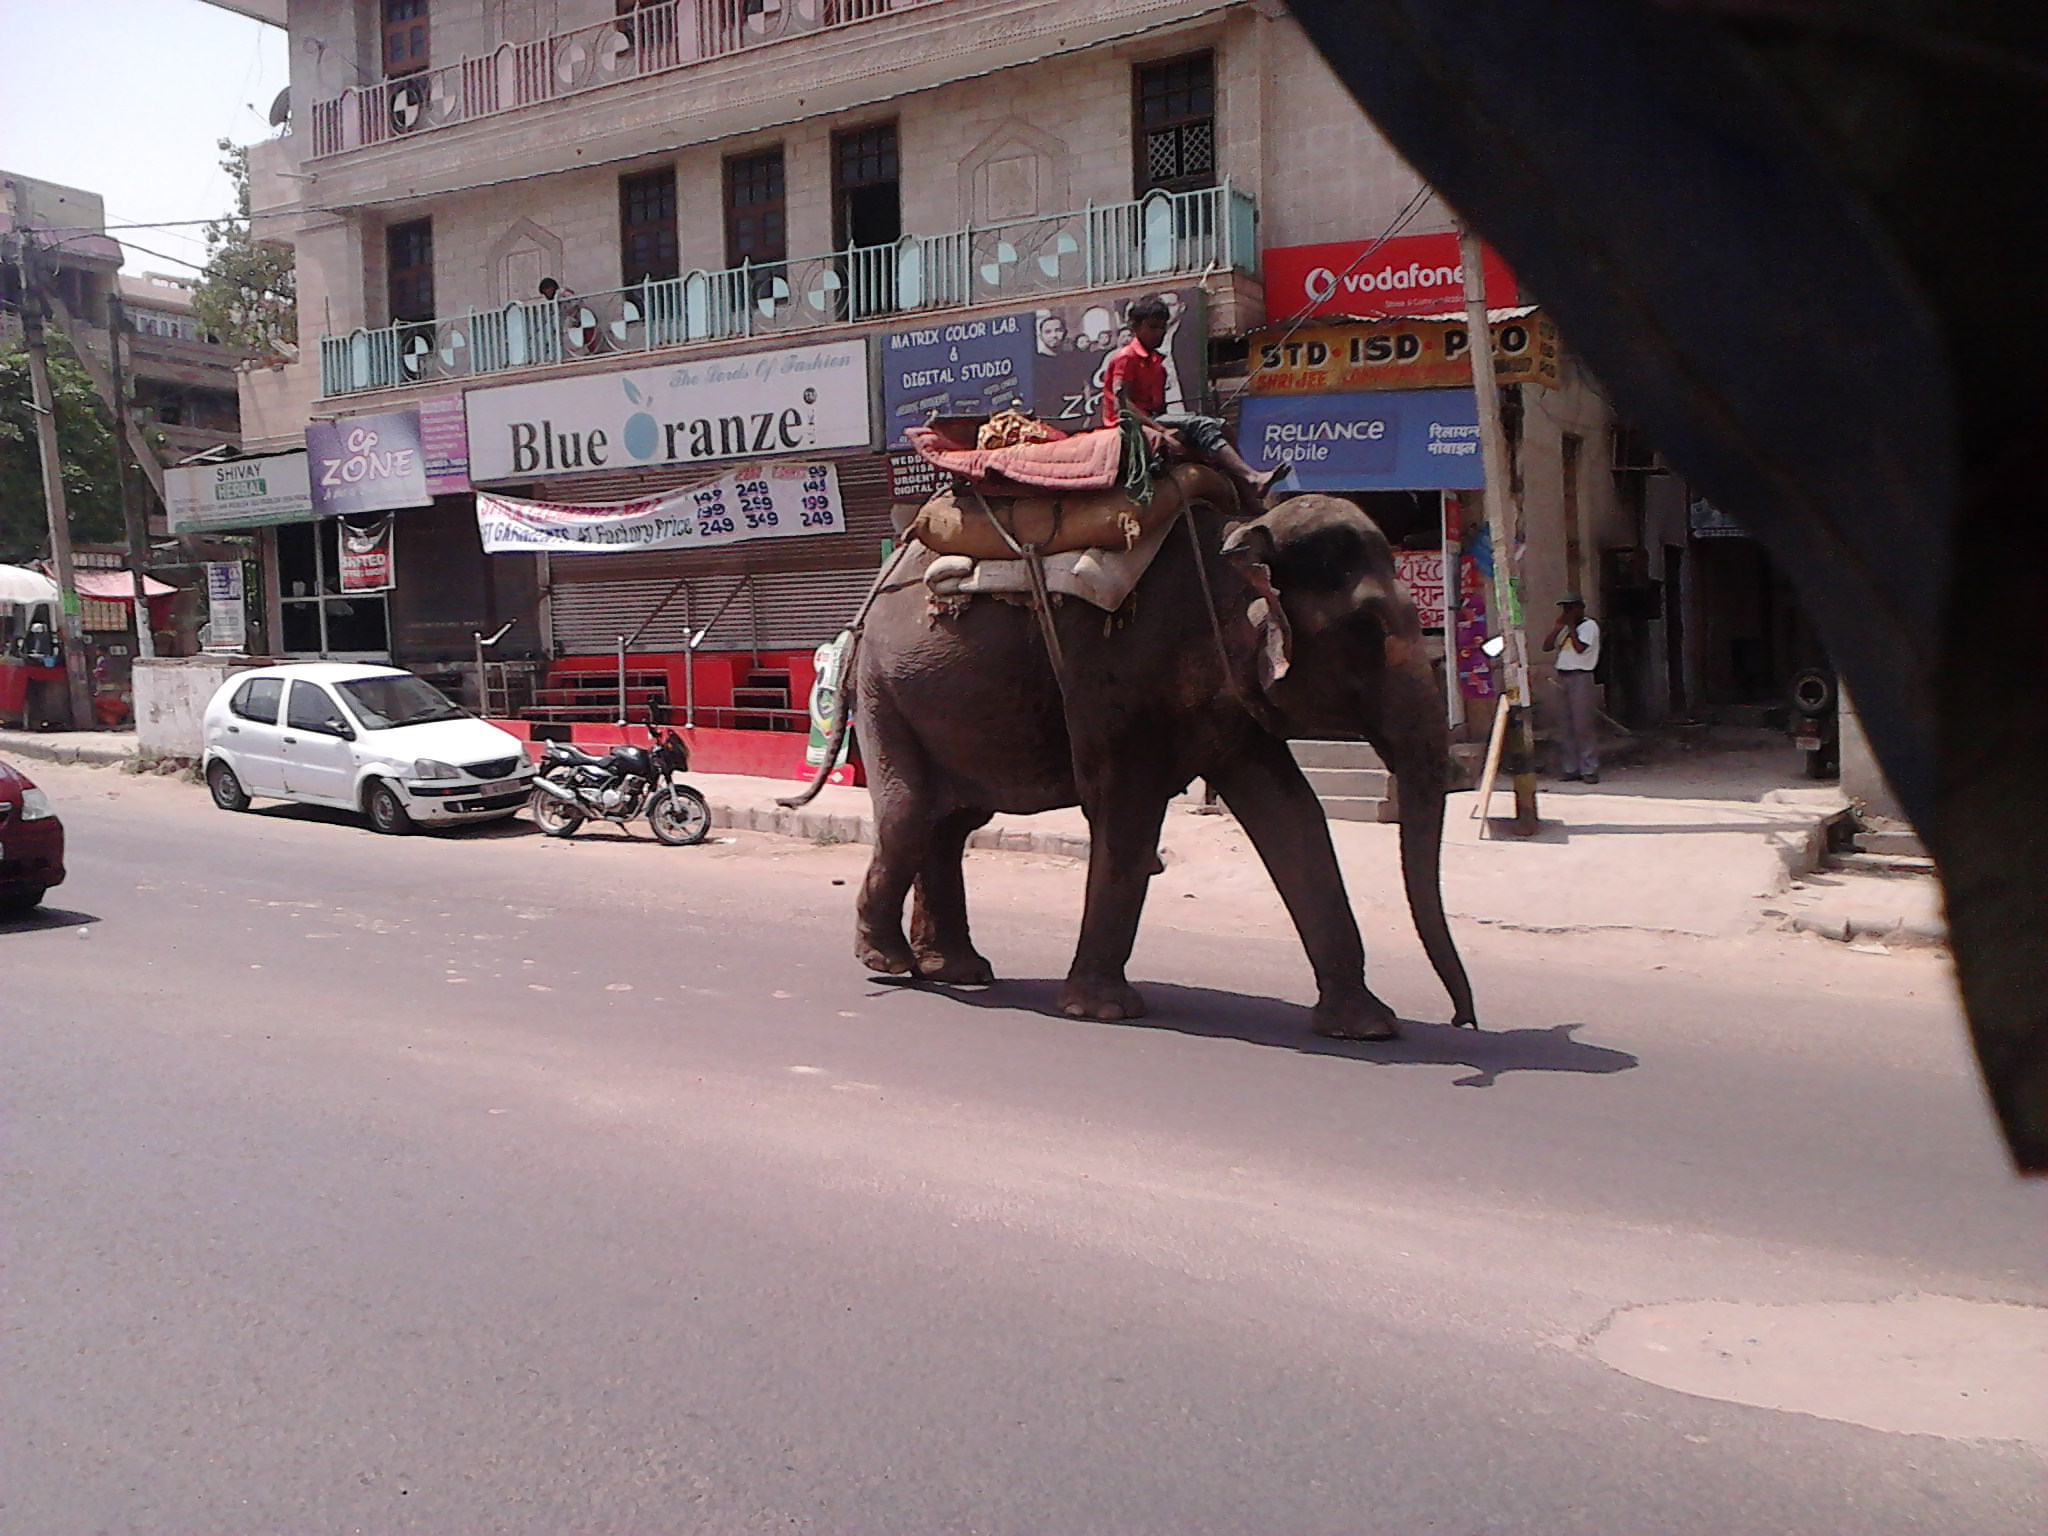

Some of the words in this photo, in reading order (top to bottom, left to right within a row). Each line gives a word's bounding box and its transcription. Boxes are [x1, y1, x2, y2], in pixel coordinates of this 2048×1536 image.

[1343, 262, 1466, 293] vodafone
[891, 329, 940, 349] MATRIX
[945, 322, 987, 341] COLOR
[992, 317, 1020, 335] LAB.
[949, 346, 959, 362] &
[1260, 341, 1330, 370] STD
[1349, 332, 1422, 367] ISD
[1444, 324, 1530, 361] PO
[903, 367, 955, 388] DIGITAL
[961, 358, 1013, 380] STUDIO
[507, 420, 609, 473] Blue
[1262, 442, 1329, 462] Mobile
[321, 448, 415, 487] ZONE
[890, 455, 922, 466] WEDD
[908, 463, 934, 474] VISA
[216, 463, 262, 482] SHIVAY
[938, 471, 953, 480] PA
[735, 481, 769, 498] 249
[801, 495, 829, 510] 199
[655, 514, 693, 538] Price
[699, 517, 735, 536] 249
[800, 510, 834, 528] 249
